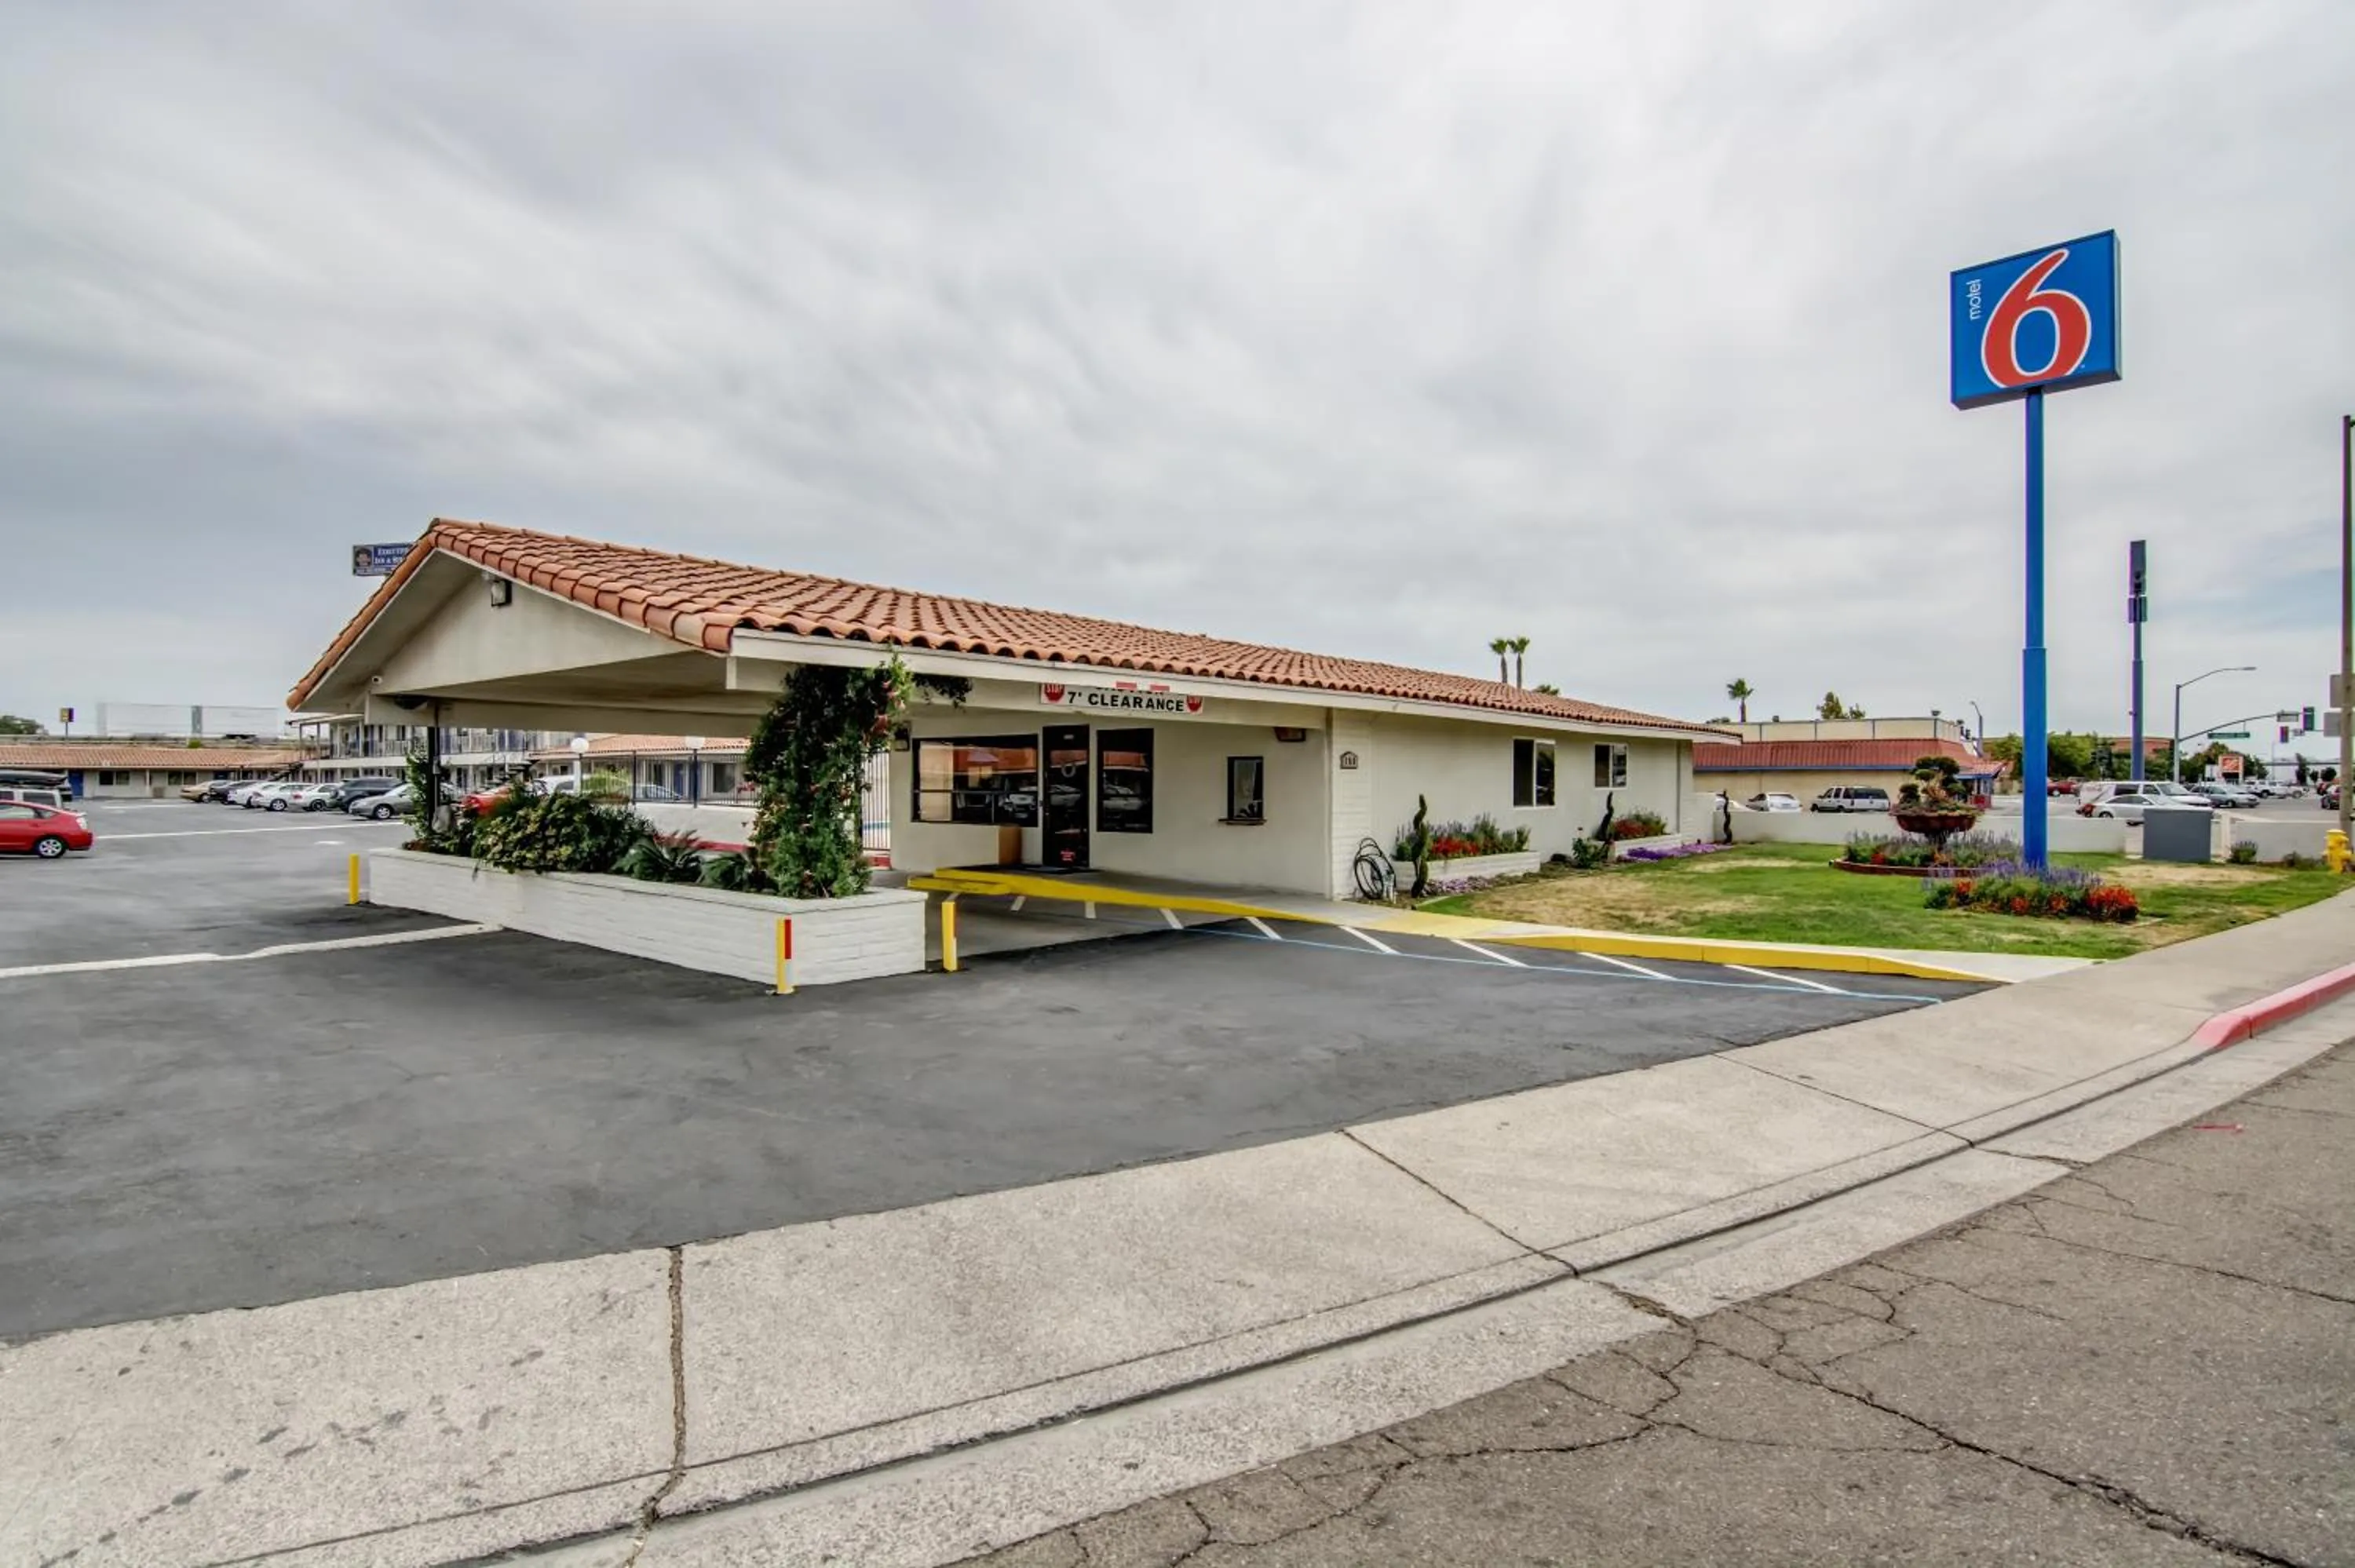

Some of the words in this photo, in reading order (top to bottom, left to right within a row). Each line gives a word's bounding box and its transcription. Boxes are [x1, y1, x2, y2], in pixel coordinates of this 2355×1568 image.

[1966, 279, 1981, 321] motel
[1981, 248, 2092, 388] 6
[1068, 691, 1083, 704] 7'
[1088, 693, 1184, 712] CLEARANCE
